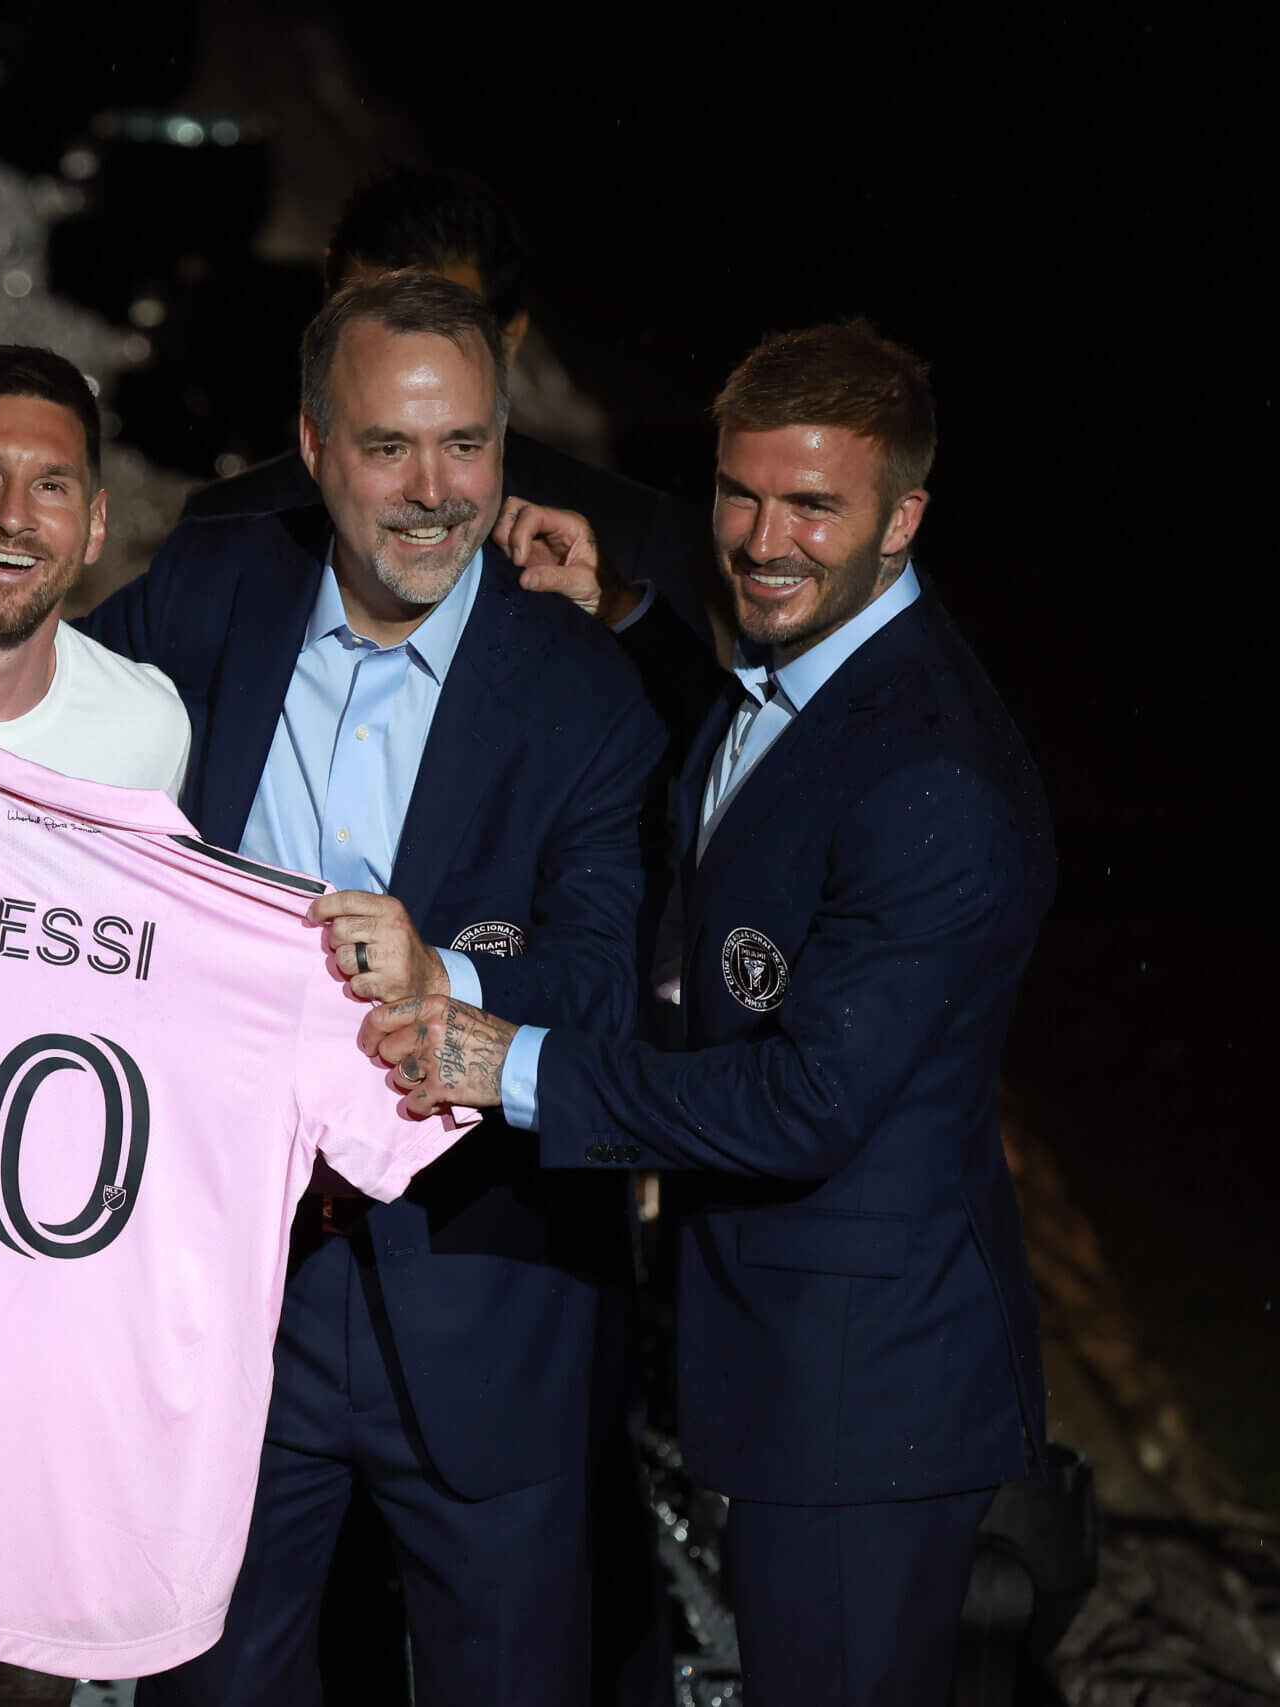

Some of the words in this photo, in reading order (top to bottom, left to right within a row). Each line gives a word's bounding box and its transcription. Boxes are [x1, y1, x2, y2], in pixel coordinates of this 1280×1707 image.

[454, 924, 516, 951] TERNACIONAL
[474, 940, 508, 951] MIAMI
[741, 948, 766, 960] MIAMI
